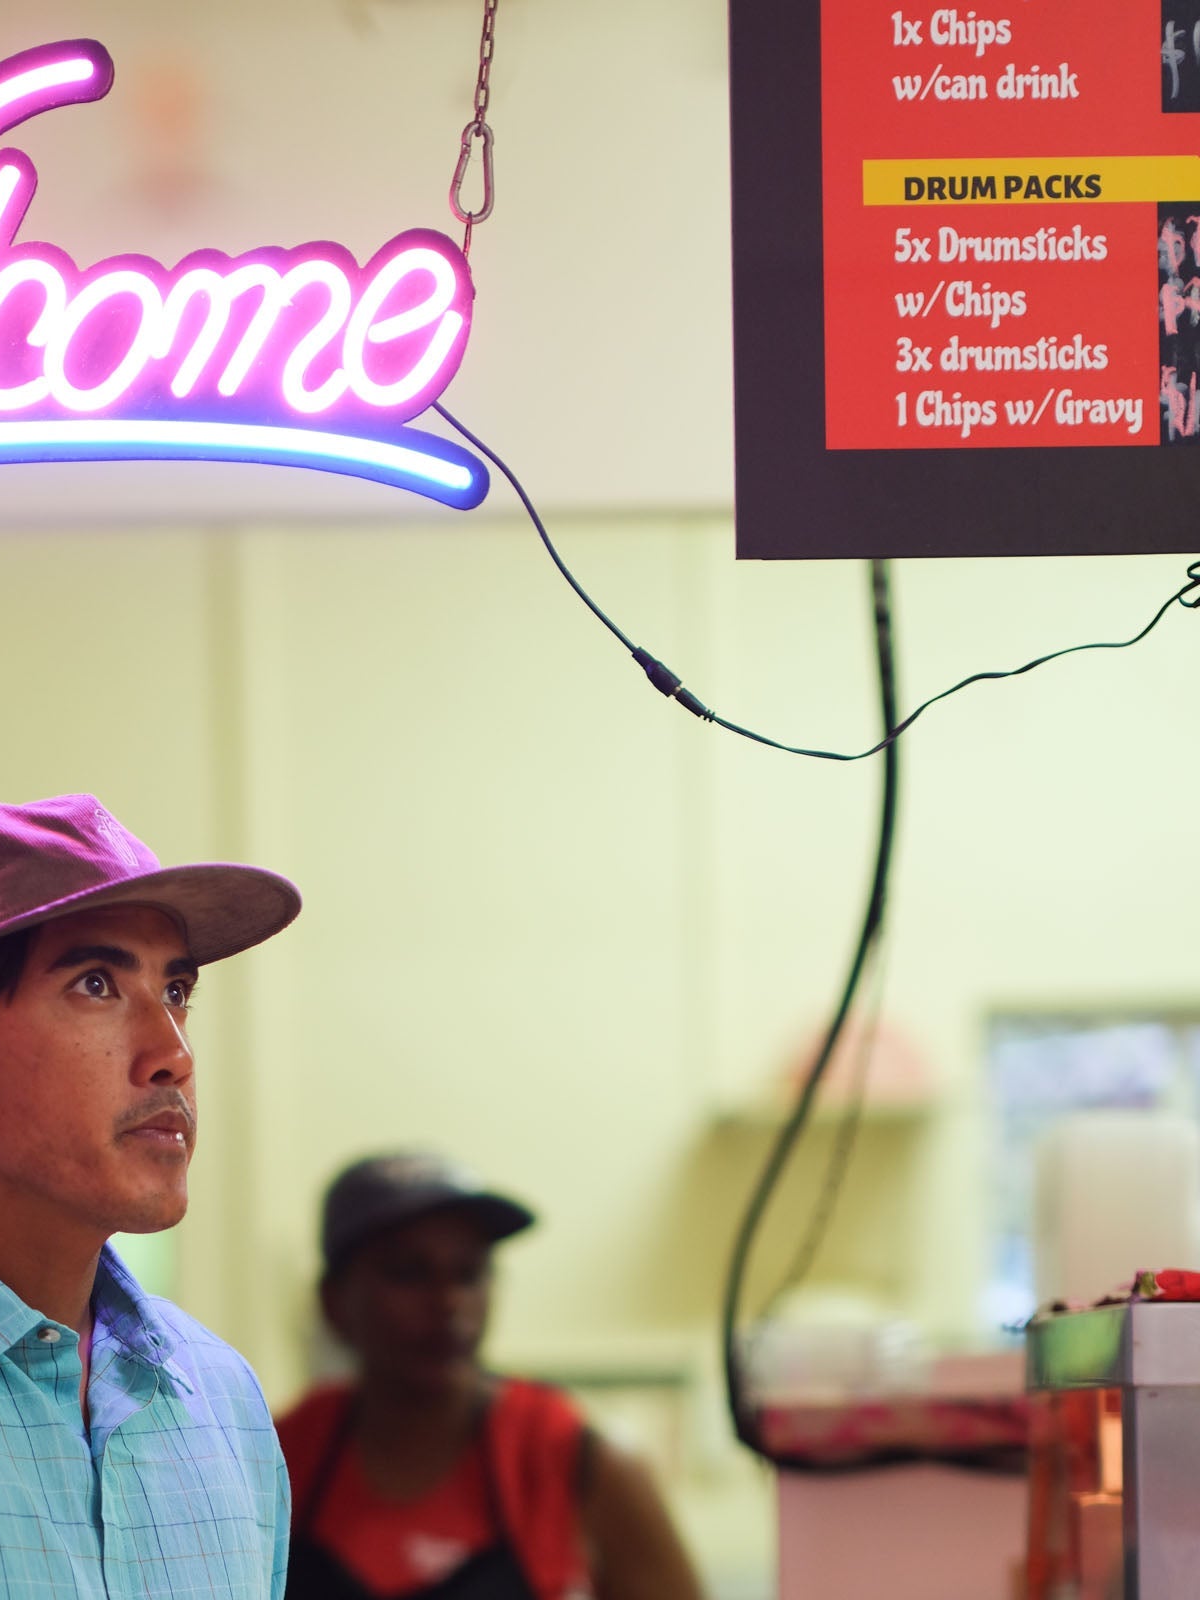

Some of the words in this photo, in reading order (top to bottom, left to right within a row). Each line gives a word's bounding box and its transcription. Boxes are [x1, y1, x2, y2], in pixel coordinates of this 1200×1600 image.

[891, 10, 923, 46] 1x
[929, 9, 1012, 57] Chips
[892, 63, 989, 101] w/can
[996, 62, 1080, 100] drink
[904, 175, 998, 201] DRUM
[1004, 174, 1102, 200] PACKS
[894, 227, 932, 263] 5x
[938, 224, 1108, 263] Drumsticks
[895, 336, 933, 372] 3x
[939, 333, 1109, 372] drumsticks
[895, 391, 907, 427] 1
[915, 390, 998, 439] Chips
